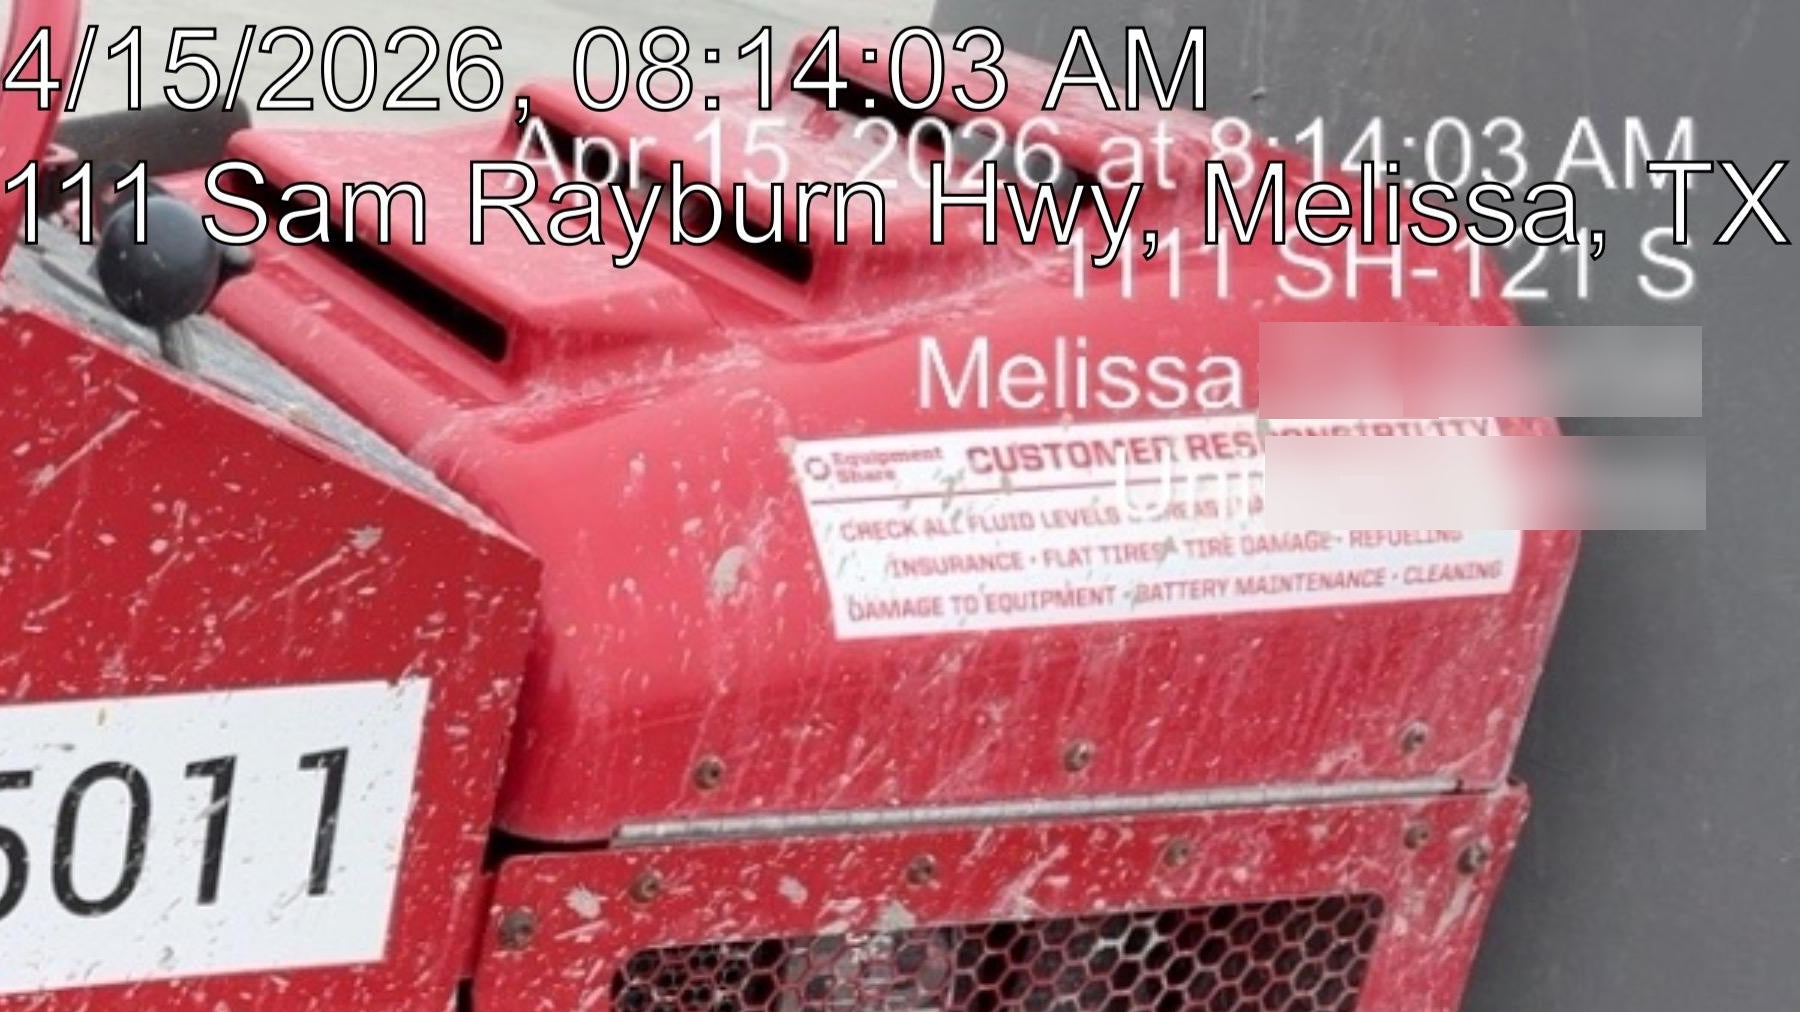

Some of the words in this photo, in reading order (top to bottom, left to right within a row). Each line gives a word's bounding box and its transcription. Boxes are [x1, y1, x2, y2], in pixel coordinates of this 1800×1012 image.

[967, 434, 1178, 474] CUSTOMER
[836, 466, 897, 484] Share
[838, 518, 915, 542] CHECK
[968, 512, 1034, 533] FLUID
[1040, 506, 1120, 530] LEVELS
[888, 551, 1024, 579] INSURANCE
[1042, 547, 1095, 568] FLAT
[1100, 541, 1170, 564] TIRES
[1183, 536, 1234, 558] TIRE
[1241, 530, 1332, 556] DAMAGE
[847, 596, 943, 622] DAMAGE
[950, 595, 980, 615] TO
[986, 586, 1116, 614] EQUIPMENT
[1134, 577, 1230, 604] BATTERY
[1234, 567, 1386, 597] MAINTENANCE
[1403, 560, 1504, 586] CLEANING
